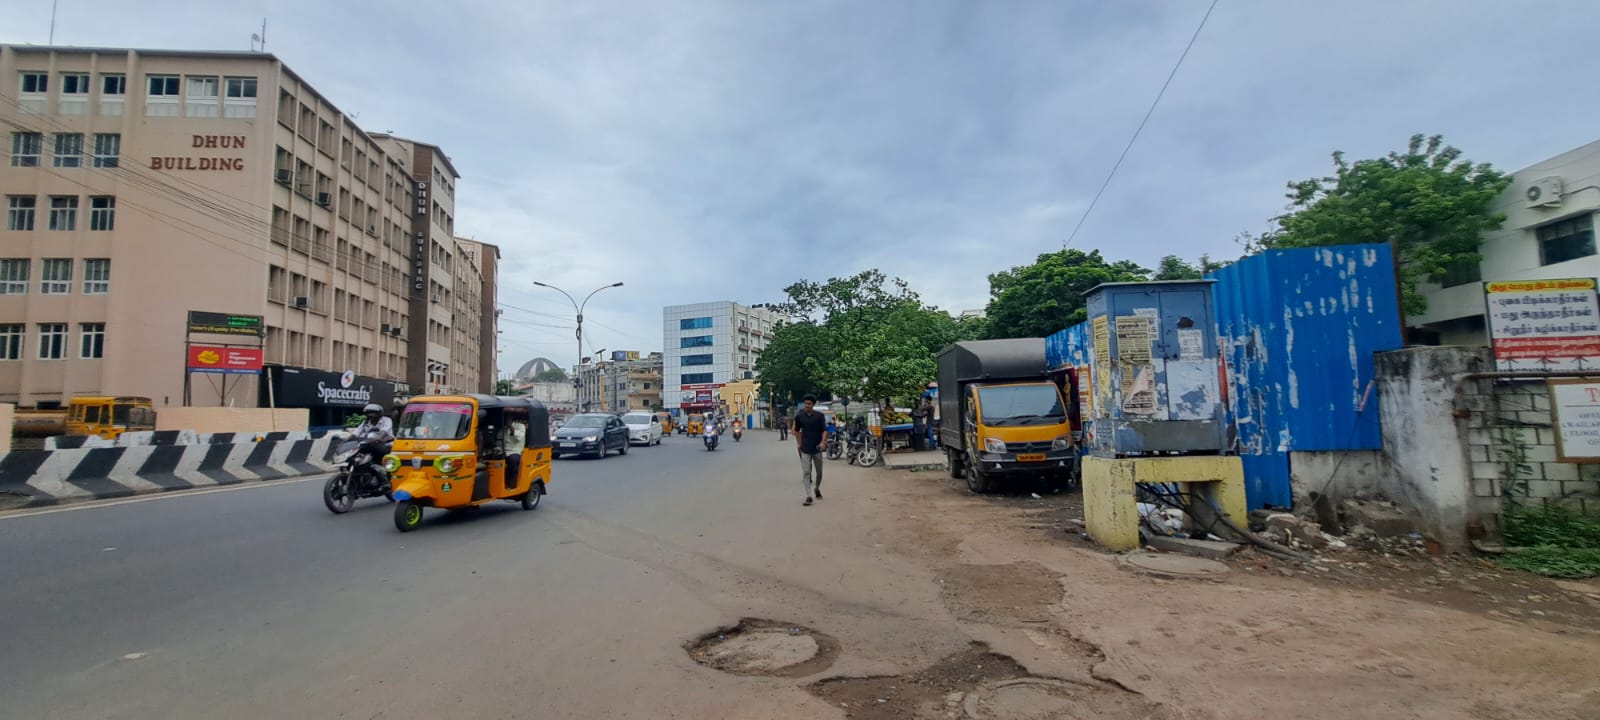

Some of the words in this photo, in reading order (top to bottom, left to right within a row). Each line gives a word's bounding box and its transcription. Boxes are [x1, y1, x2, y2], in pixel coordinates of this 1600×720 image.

[192, 134, 246, 149] DHUN
[150, 156, 245, 171] BUILDING
[418, 182, 427, 214] DHUN
[317, 381, 370, 404] Spacecrafts
